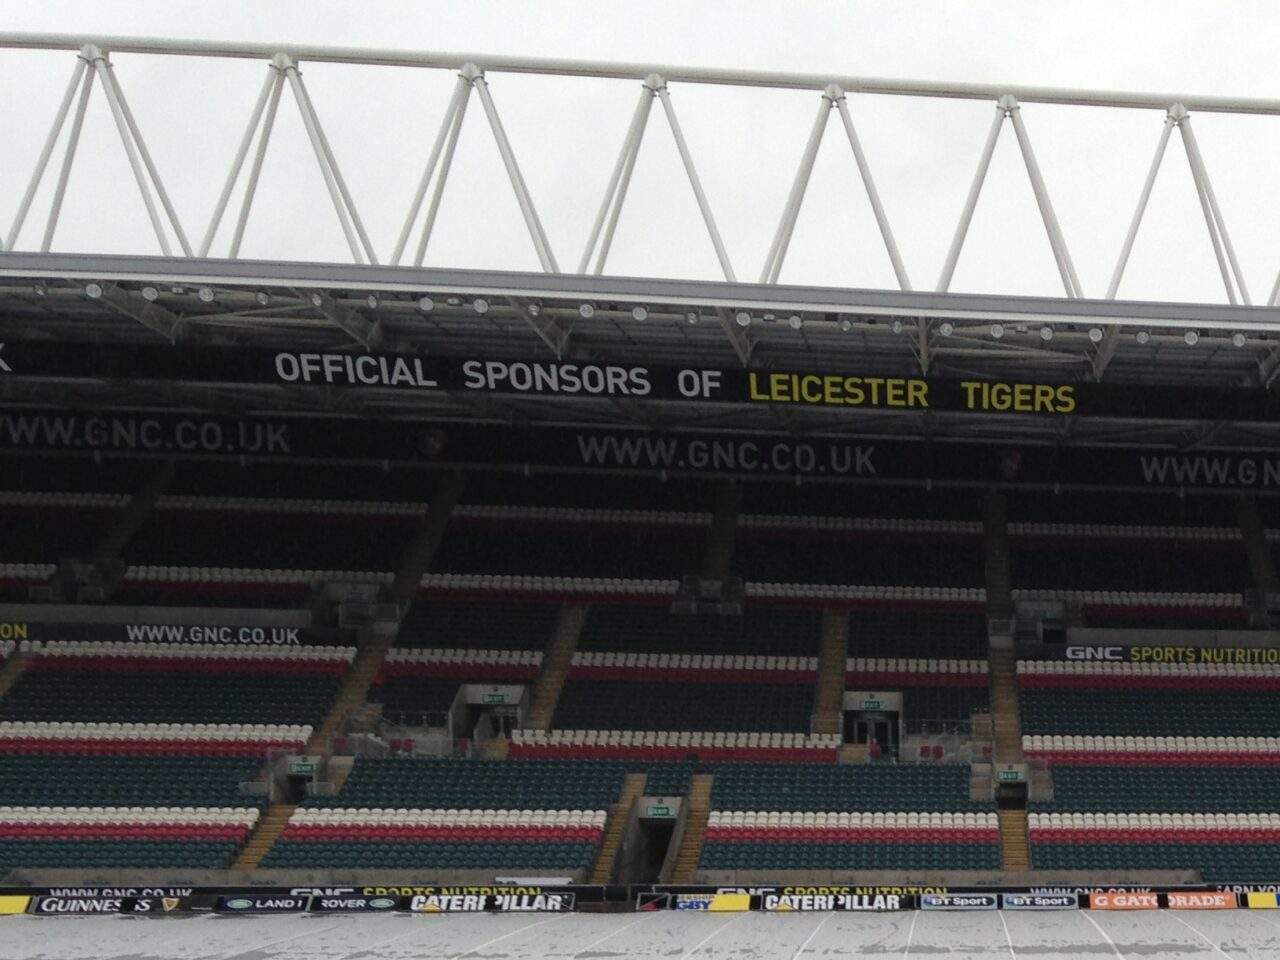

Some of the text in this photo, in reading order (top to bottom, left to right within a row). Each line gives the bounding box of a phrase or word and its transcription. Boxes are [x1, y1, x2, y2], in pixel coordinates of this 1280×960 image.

[275, 353, 1076, 413] OFFICIAL SPONSORS OF LEICESTER TIGERS
[1, 415, 290, 452] WW.GNC.CO.UK
[577, 433, 876, 474] WWW.GNC.CO.UK
[126, 624, 300, 644] WWW.GNC.CO.UK
[1066, 646, 1123, 660] GNC
[1130, 647, 1196, 662] SPORTS
[255, 899, 295, 908] LAND
[765, 895, 901, 910] CATERPILLAR
[932, 897, 987, 906] BT Sport
[1013, 897, 1069, 906] BT Sport
[1113, 895, 1225, 907] GATORADE
